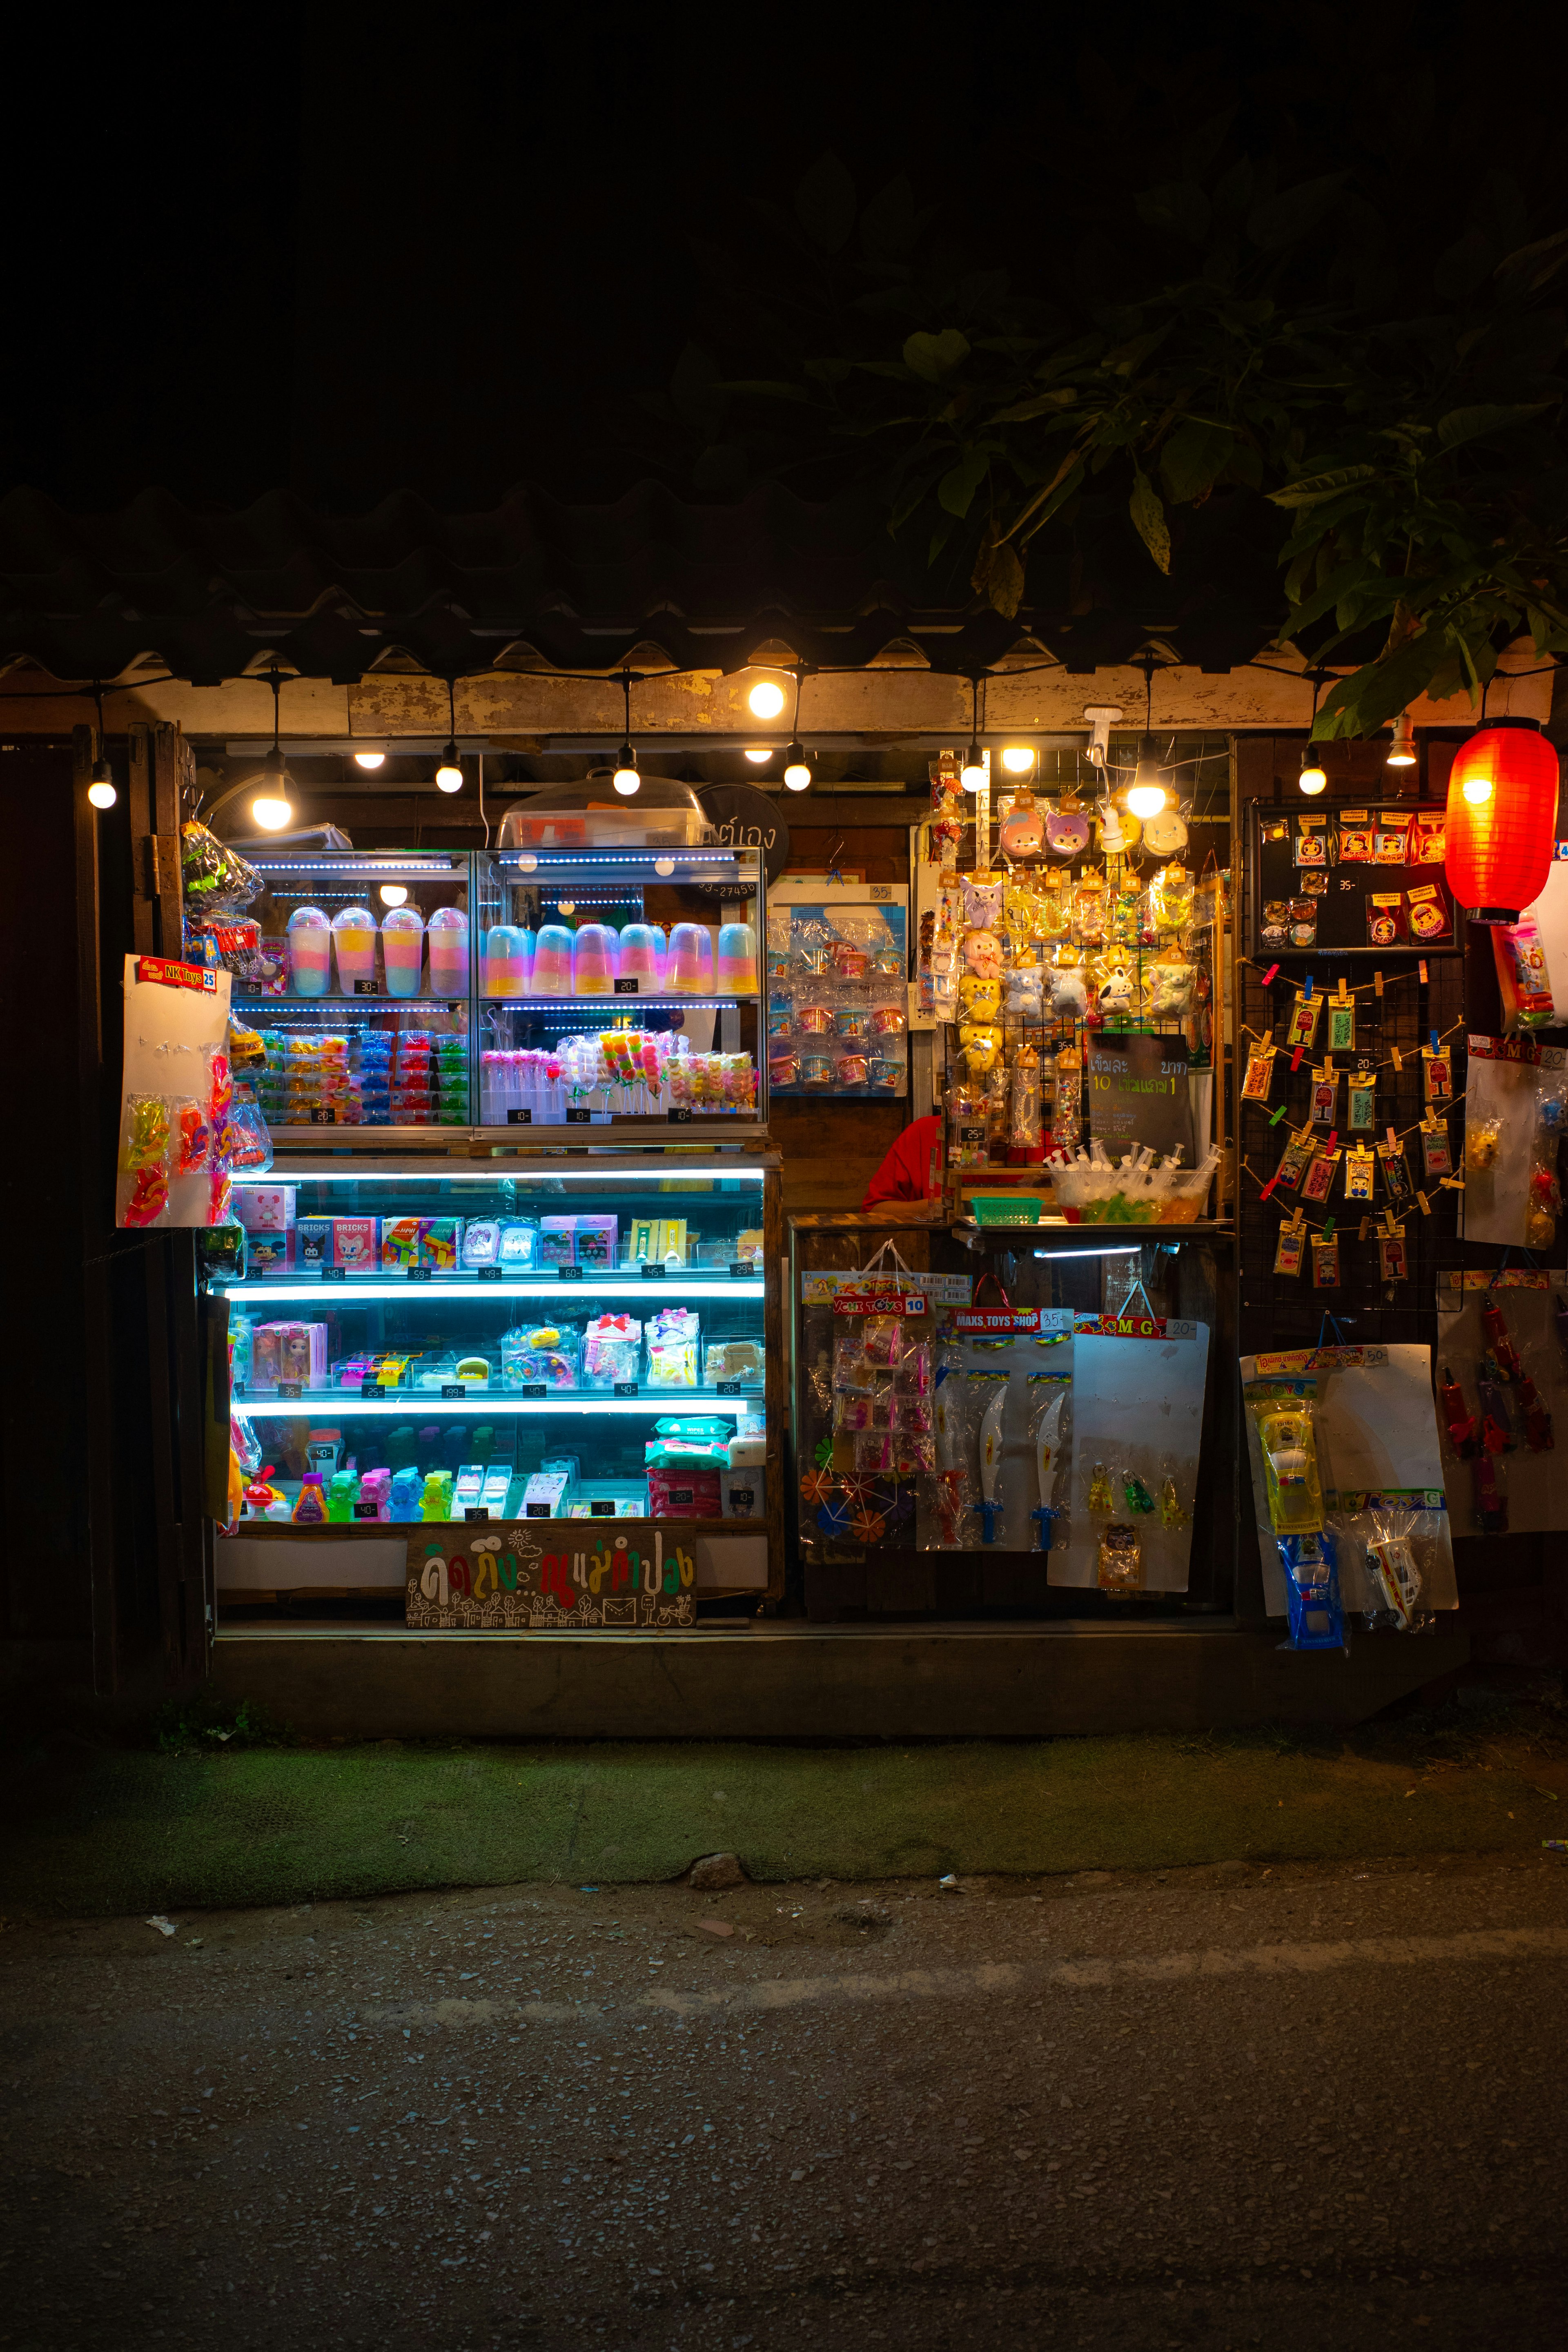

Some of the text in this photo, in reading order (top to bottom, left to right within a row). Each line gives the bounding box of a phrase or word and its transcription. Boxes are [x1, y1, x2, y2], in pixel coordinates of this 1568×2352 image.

[1340, 880, 1355, 890] 35-
[873, 887, 891, 899] 35-
[1410, 886, 1433, 895] handmade
[165, 964, 202, 985] NK Toys
[204, 974, 214, 985] 25
[248, 984, 259, 993] 10-
[361, 982, 376, 991] 30-
[621, 982, 636, 991] 20-
[1058, 1041, 1072, 1051] 35-
[1507, 1043, 1536, 1061] M G
[1544, 1049, 1567, 1065] 20-
[1091, 1054, 1187, 1075] เข็มละ บาท
[1357, 1059, 1374, 1069] 20-
[1093, 1075, 1111, 1091] 10
[1170, 1076, 1176, 1096] 1
[318, 1111, 332, 1120] 20-
[517, 1112, 529, 1120] 10-
[576, 1111, 588, 1120] 10-
[677, 1111, 690, 1120] 10-
[968, 1129, 983, 1139] 25-
[328, 1270, 343, 1278] 40-
[485, 1270, 500, 1278] 49-
[565, 1269, 580, 1278] 60-
[648, 1268, 663, 1276] 45-
[737, 1265, 752, 1274] 29-
[414, 1270, 428, 1279] 59-
[862, 1280, 911, 1294] DIRECTOR
[866, 1297, 903, 1313] TOYS
[907, 1300, 923, 1312] 10
[956, 1315, 1038, 1327] MAXS TOYS SHOP
[1043, 1313, 1063, 1327] 35-
[1118, 1319, 1154, 1335] M G
[1173, 1321, 1196, 1334] 20-
[1368, 1350, 1387, 1362] 50-
[285, 1387, 299, 1396] 35-
[368, 1388, 383, 1397] 25-
[446, 1388, 463, 1397] 199-
[529, 1387, 545, 1396] 40-
[621, 1385, 636, 1394] 40-
[724, 1384, 738, 1393] 20-
[1261, 1382, 1305, 1396] TOYS
[316, 1449, 331, 1458] 40-
[676, 1492, 690, 1501] 20-
[740, 1493, 752, 1502] 10-
[361, 1506, 375, 1515] 40-
[533, 1506, 548, 1516] 20-
[601, 1503, 613, 1514] 10-
[472, 1510, 486, 1519] 35-
